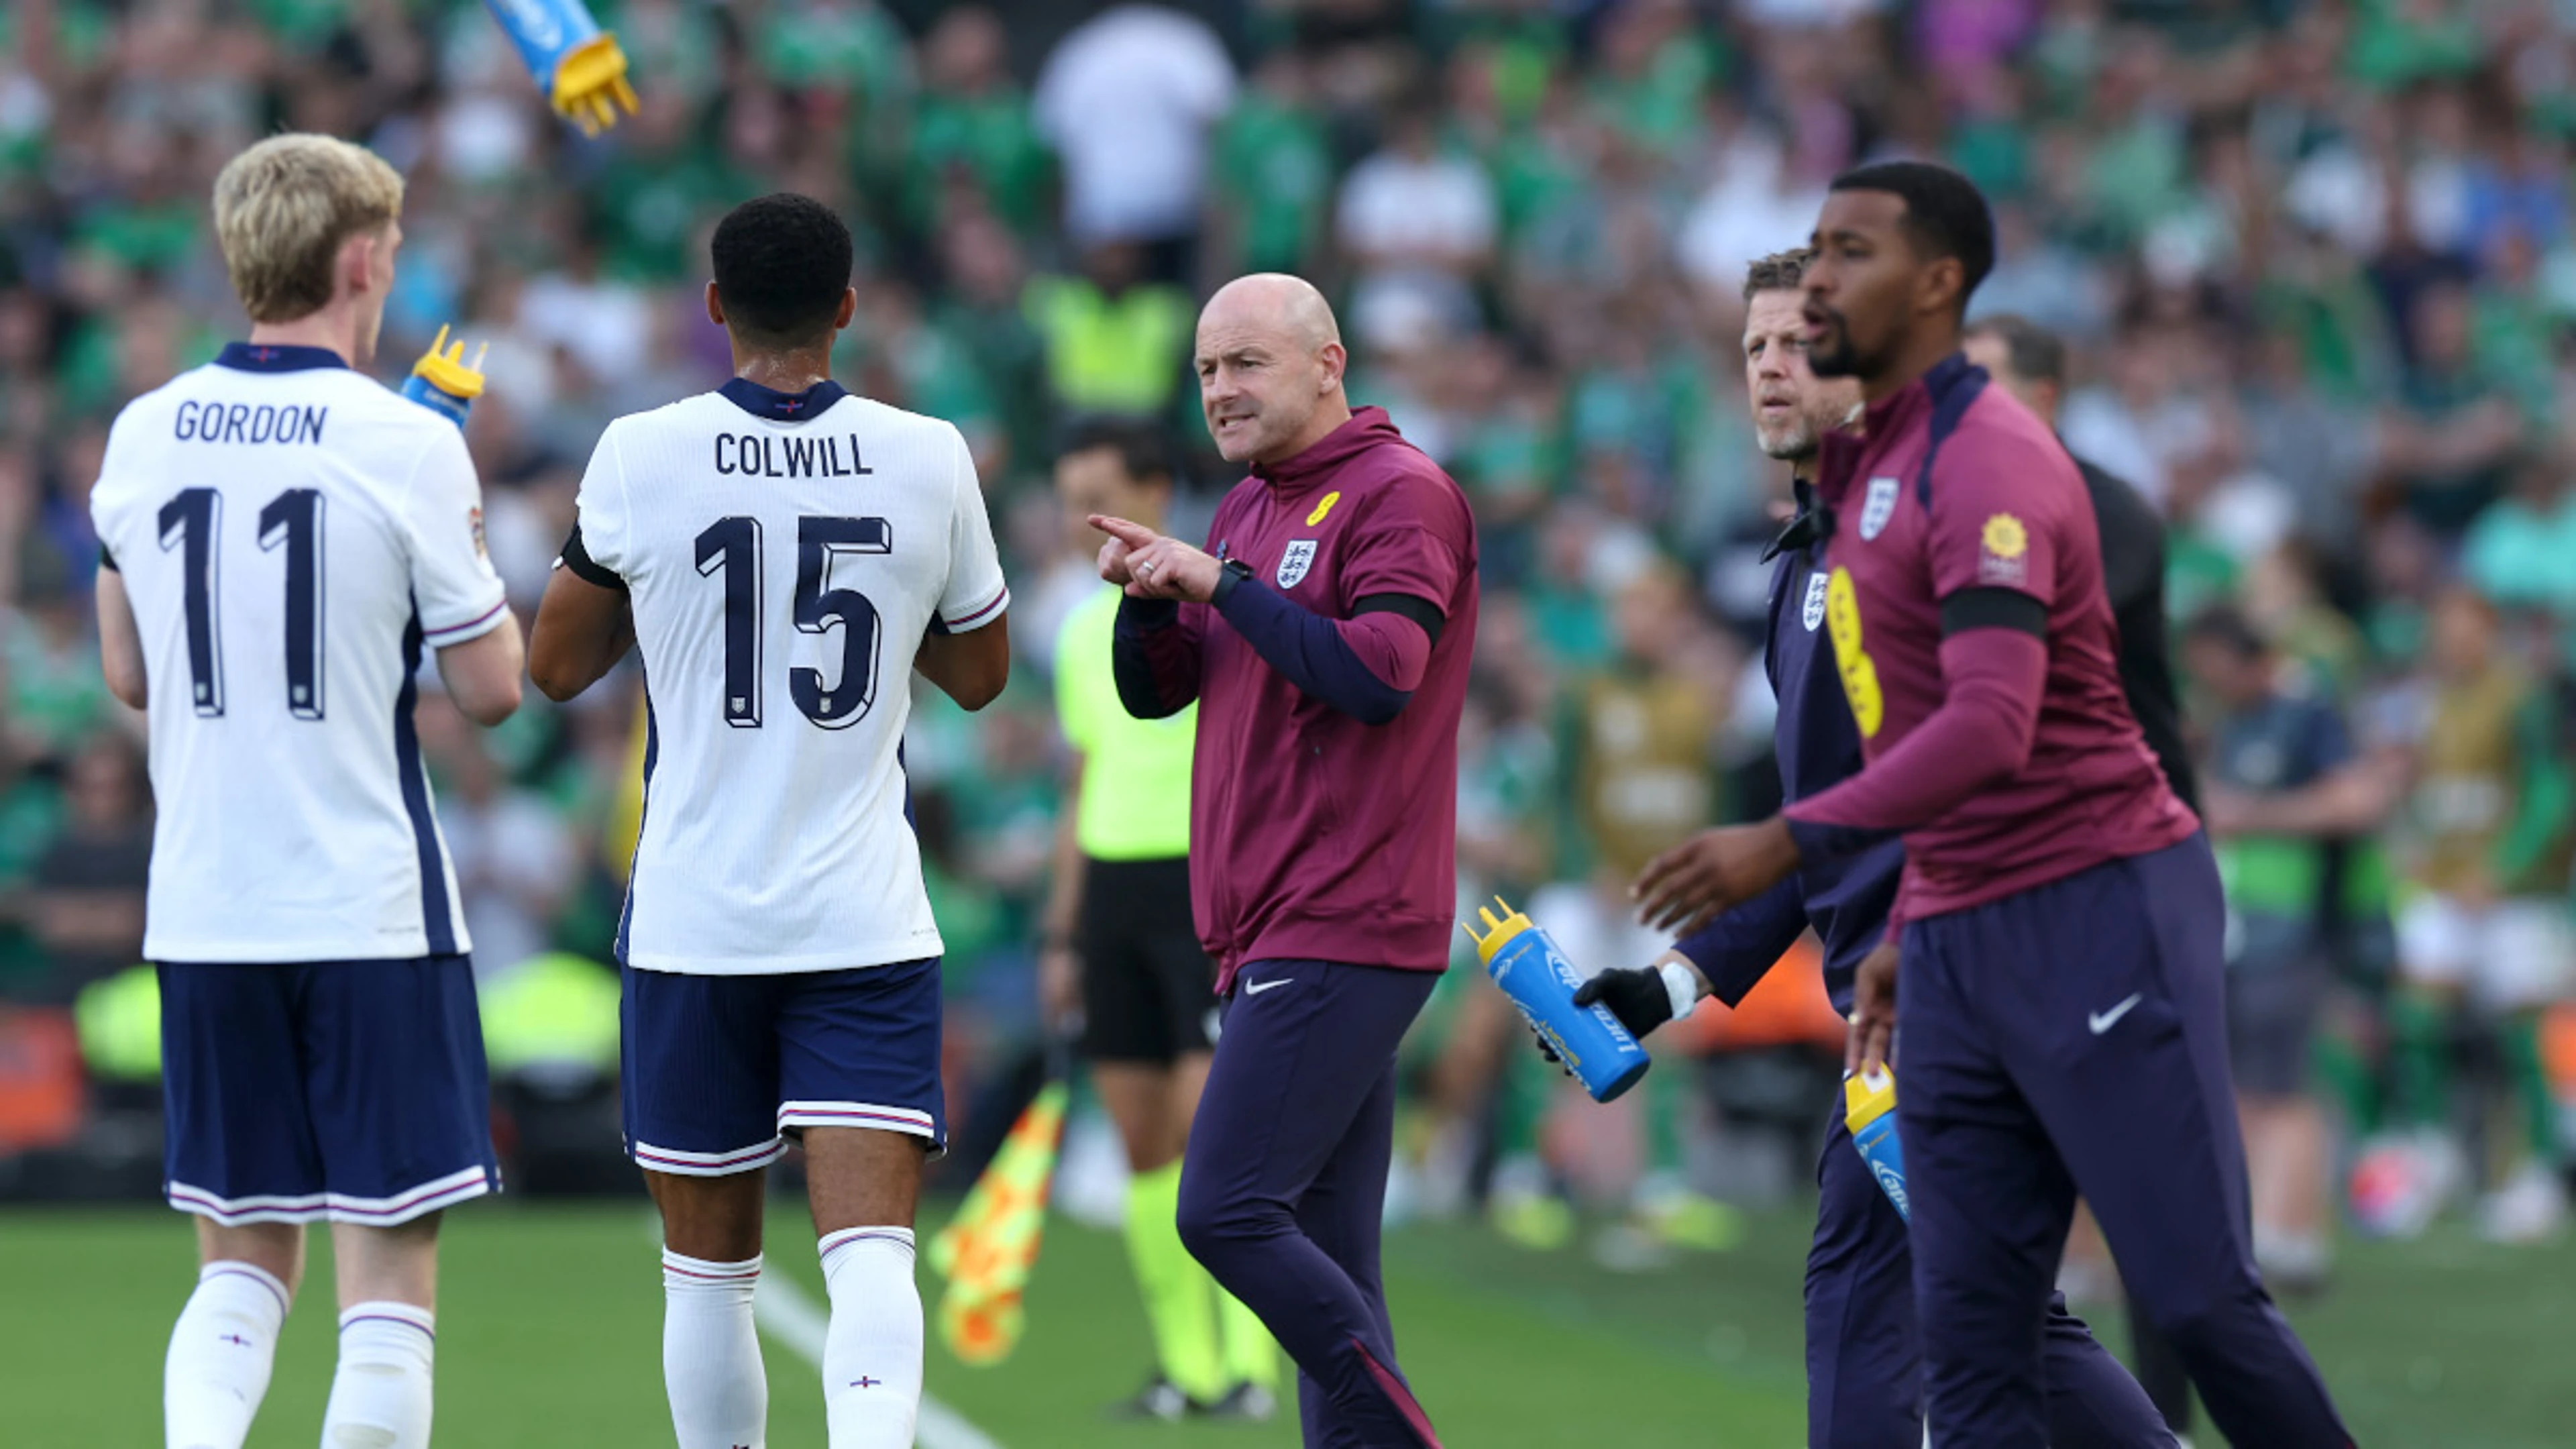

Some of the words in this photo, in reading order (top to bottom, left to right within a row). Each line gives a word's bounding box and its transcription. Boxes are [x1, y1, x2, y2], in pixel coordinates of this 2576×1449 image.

[174, 400, 328, 445] GORDON
[715, 433, 874, 478] COLWILL
[158, 488, 325, 720] 11
[695, 516, 892, 730] 15
